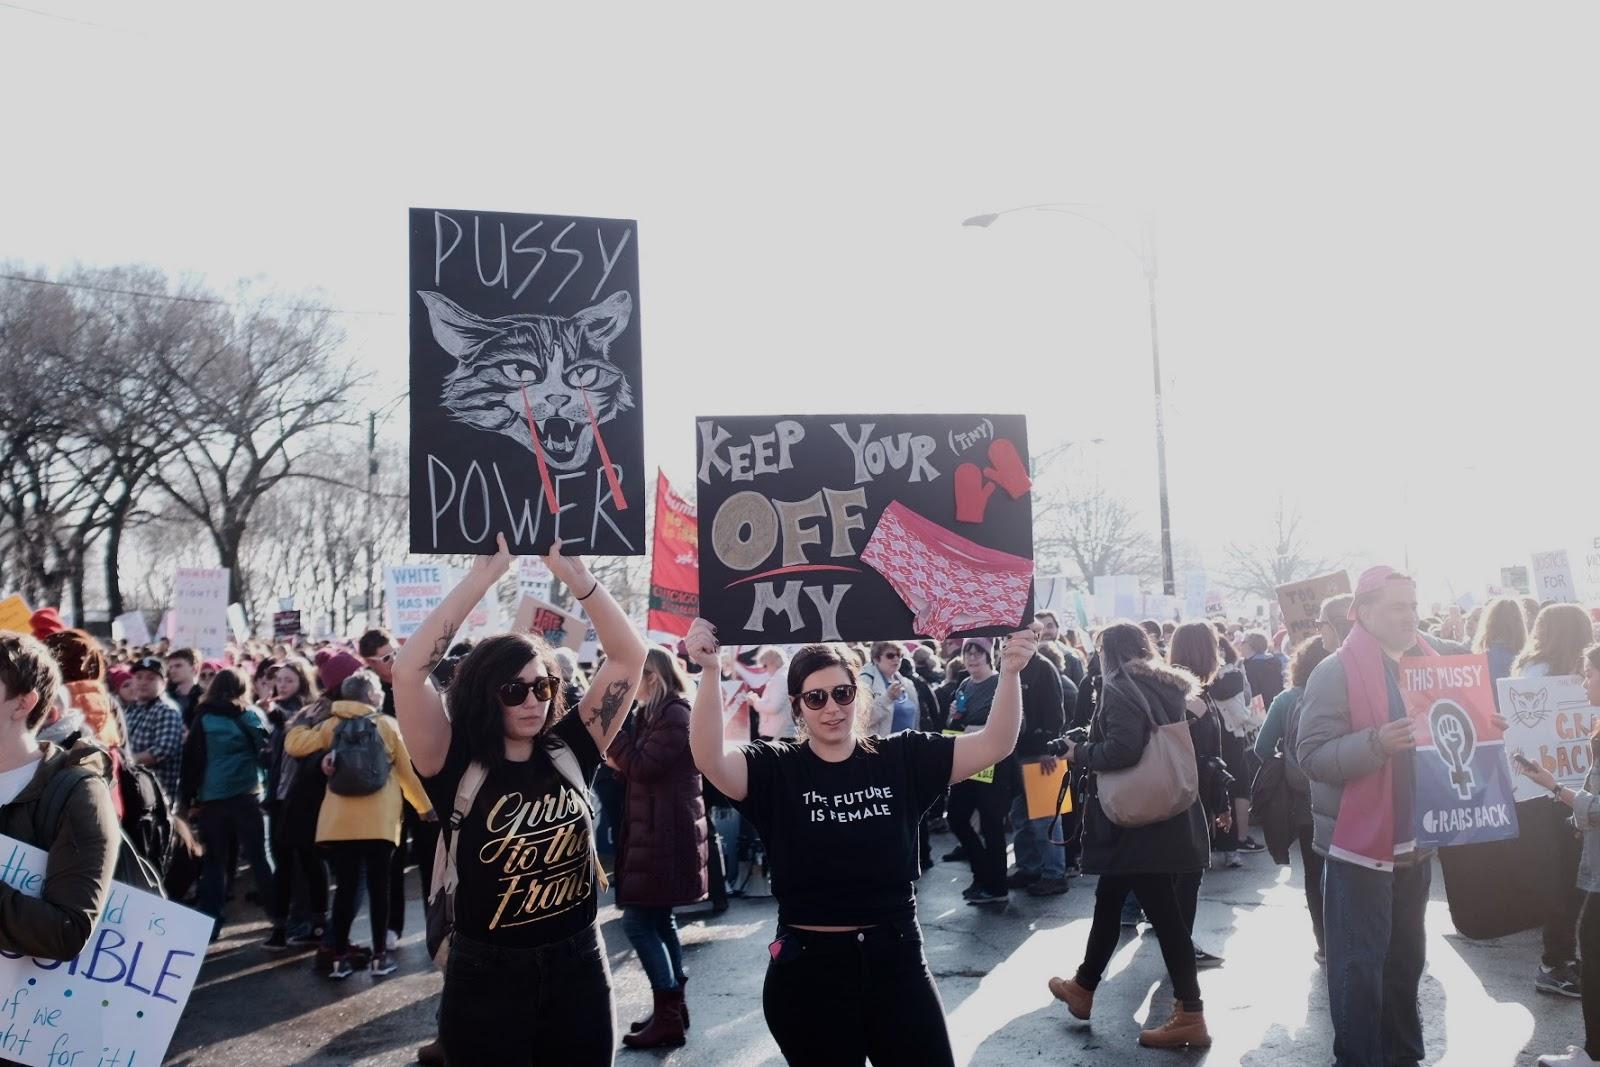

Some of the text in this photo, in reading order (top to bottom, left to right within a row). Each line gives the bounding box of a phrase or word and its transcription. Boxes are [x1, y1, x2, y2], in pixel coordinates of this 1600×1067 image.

[434, 211, 632, 303] PUSSY
[697, 420, 806, 485] KEEP
[830, 422, 941, 484] YOUR
[427, 454, 635, 551] POWER
[712, 486, 868, 571] OFF
[392, 568, 440, 584] WHITE
[1543, 574, 1567, 588] FOR
[742, 580, 853, 641] MY
[1404, 664, 1483, 692] THIS PUSSY
[833, 786, 893, 807] FUTURE
[811, 808, 826, 822] IS
[1422, 803, 1511, 833] GRABS BACK
[503, 823, 589, 873] to the
[147, 911, 167, 937] is
[1, 987, 63, 1028] if we
[47, 1032, 85, 1067] for
